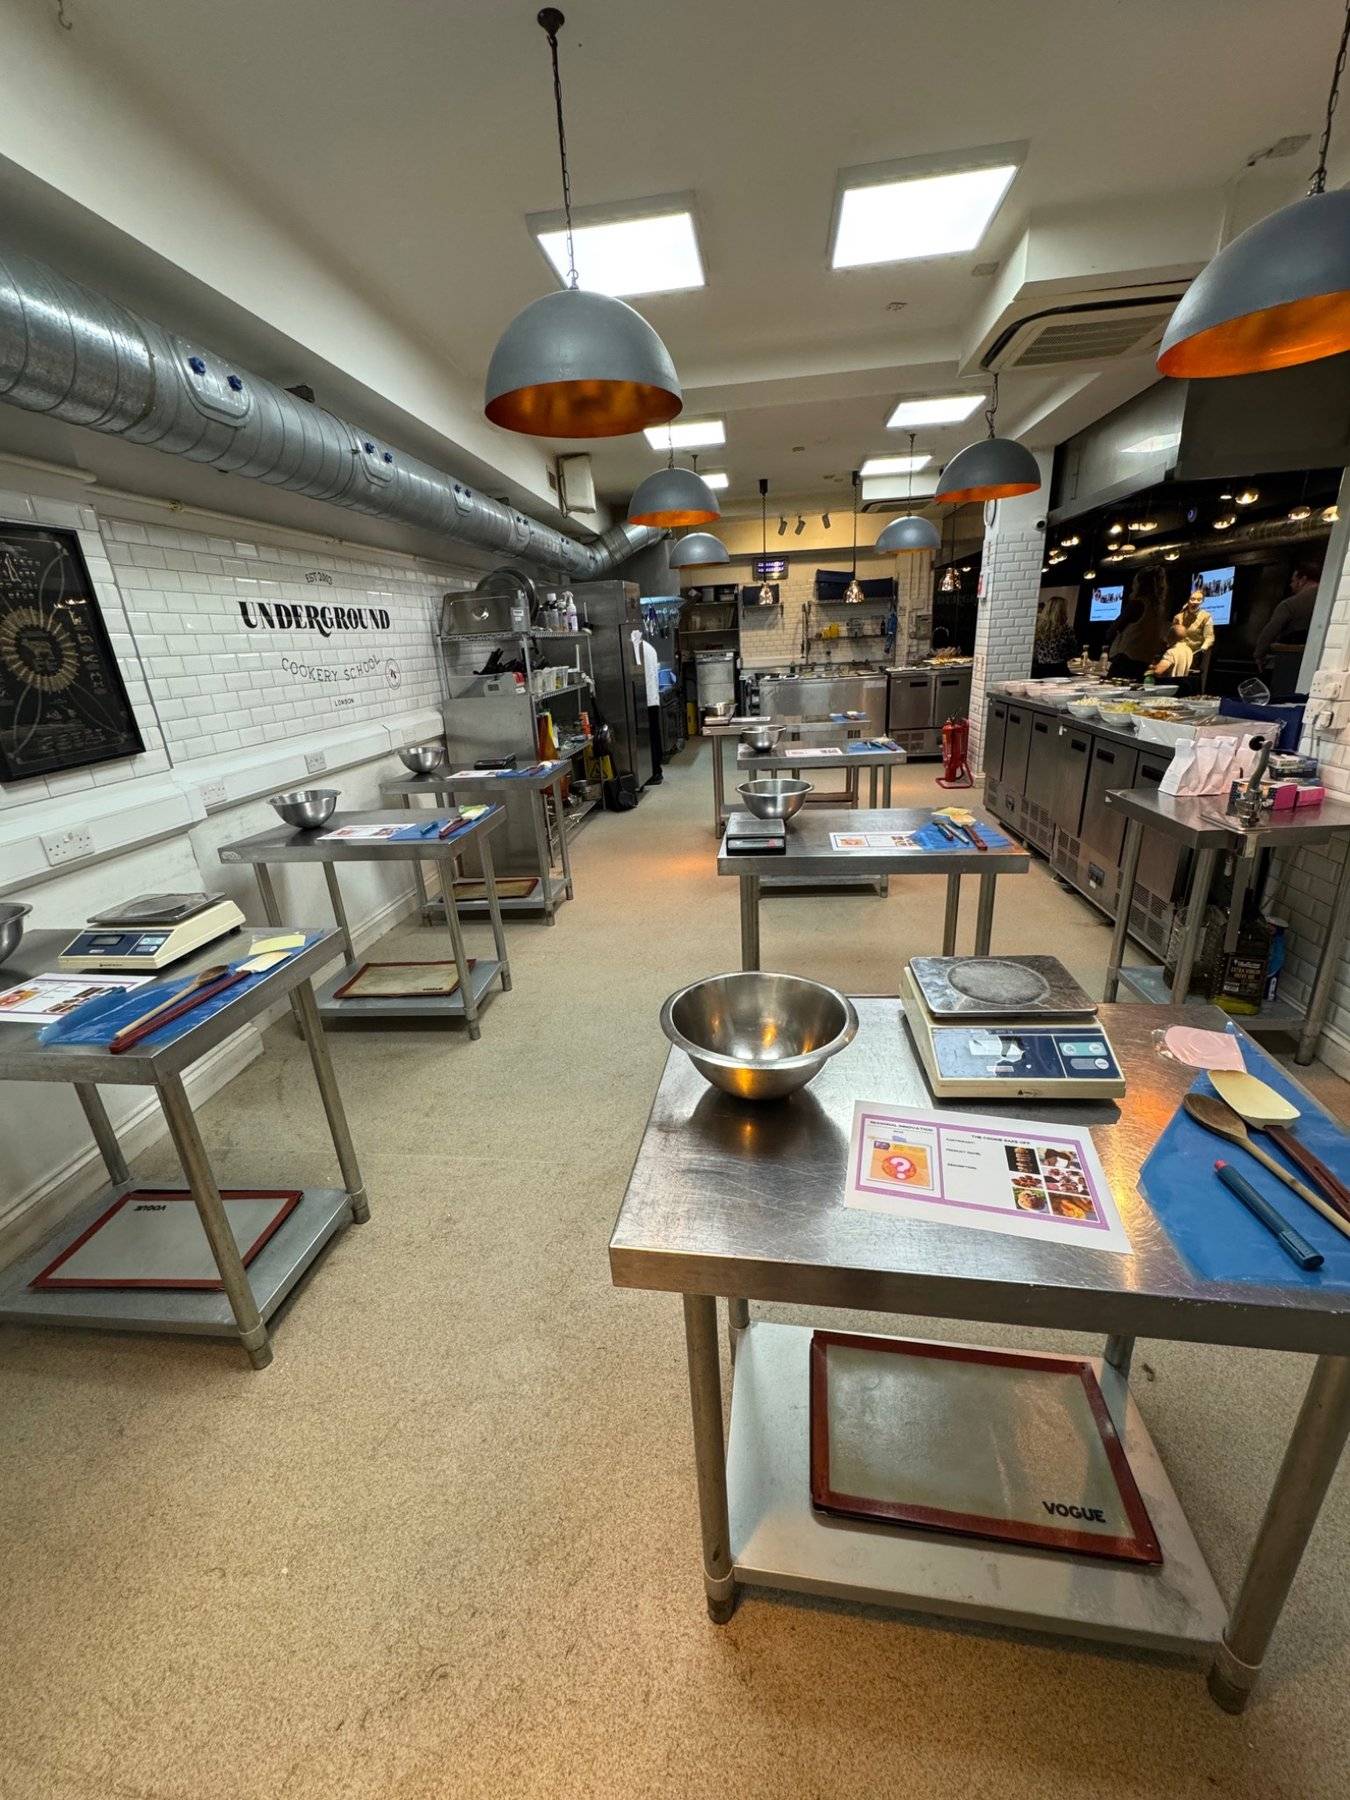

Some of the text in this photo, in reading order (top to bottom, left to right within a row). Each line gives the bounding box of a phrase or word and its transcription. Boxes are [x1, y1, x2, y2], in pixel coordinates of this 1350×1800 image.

[238, 601, 391, 638] UNDERGROUND
[281, 657, 338, 682] COOKERY
[343, 654, 381, 682] SCHOOL
[1042, 1500, 1106, 1524] VOGUE
